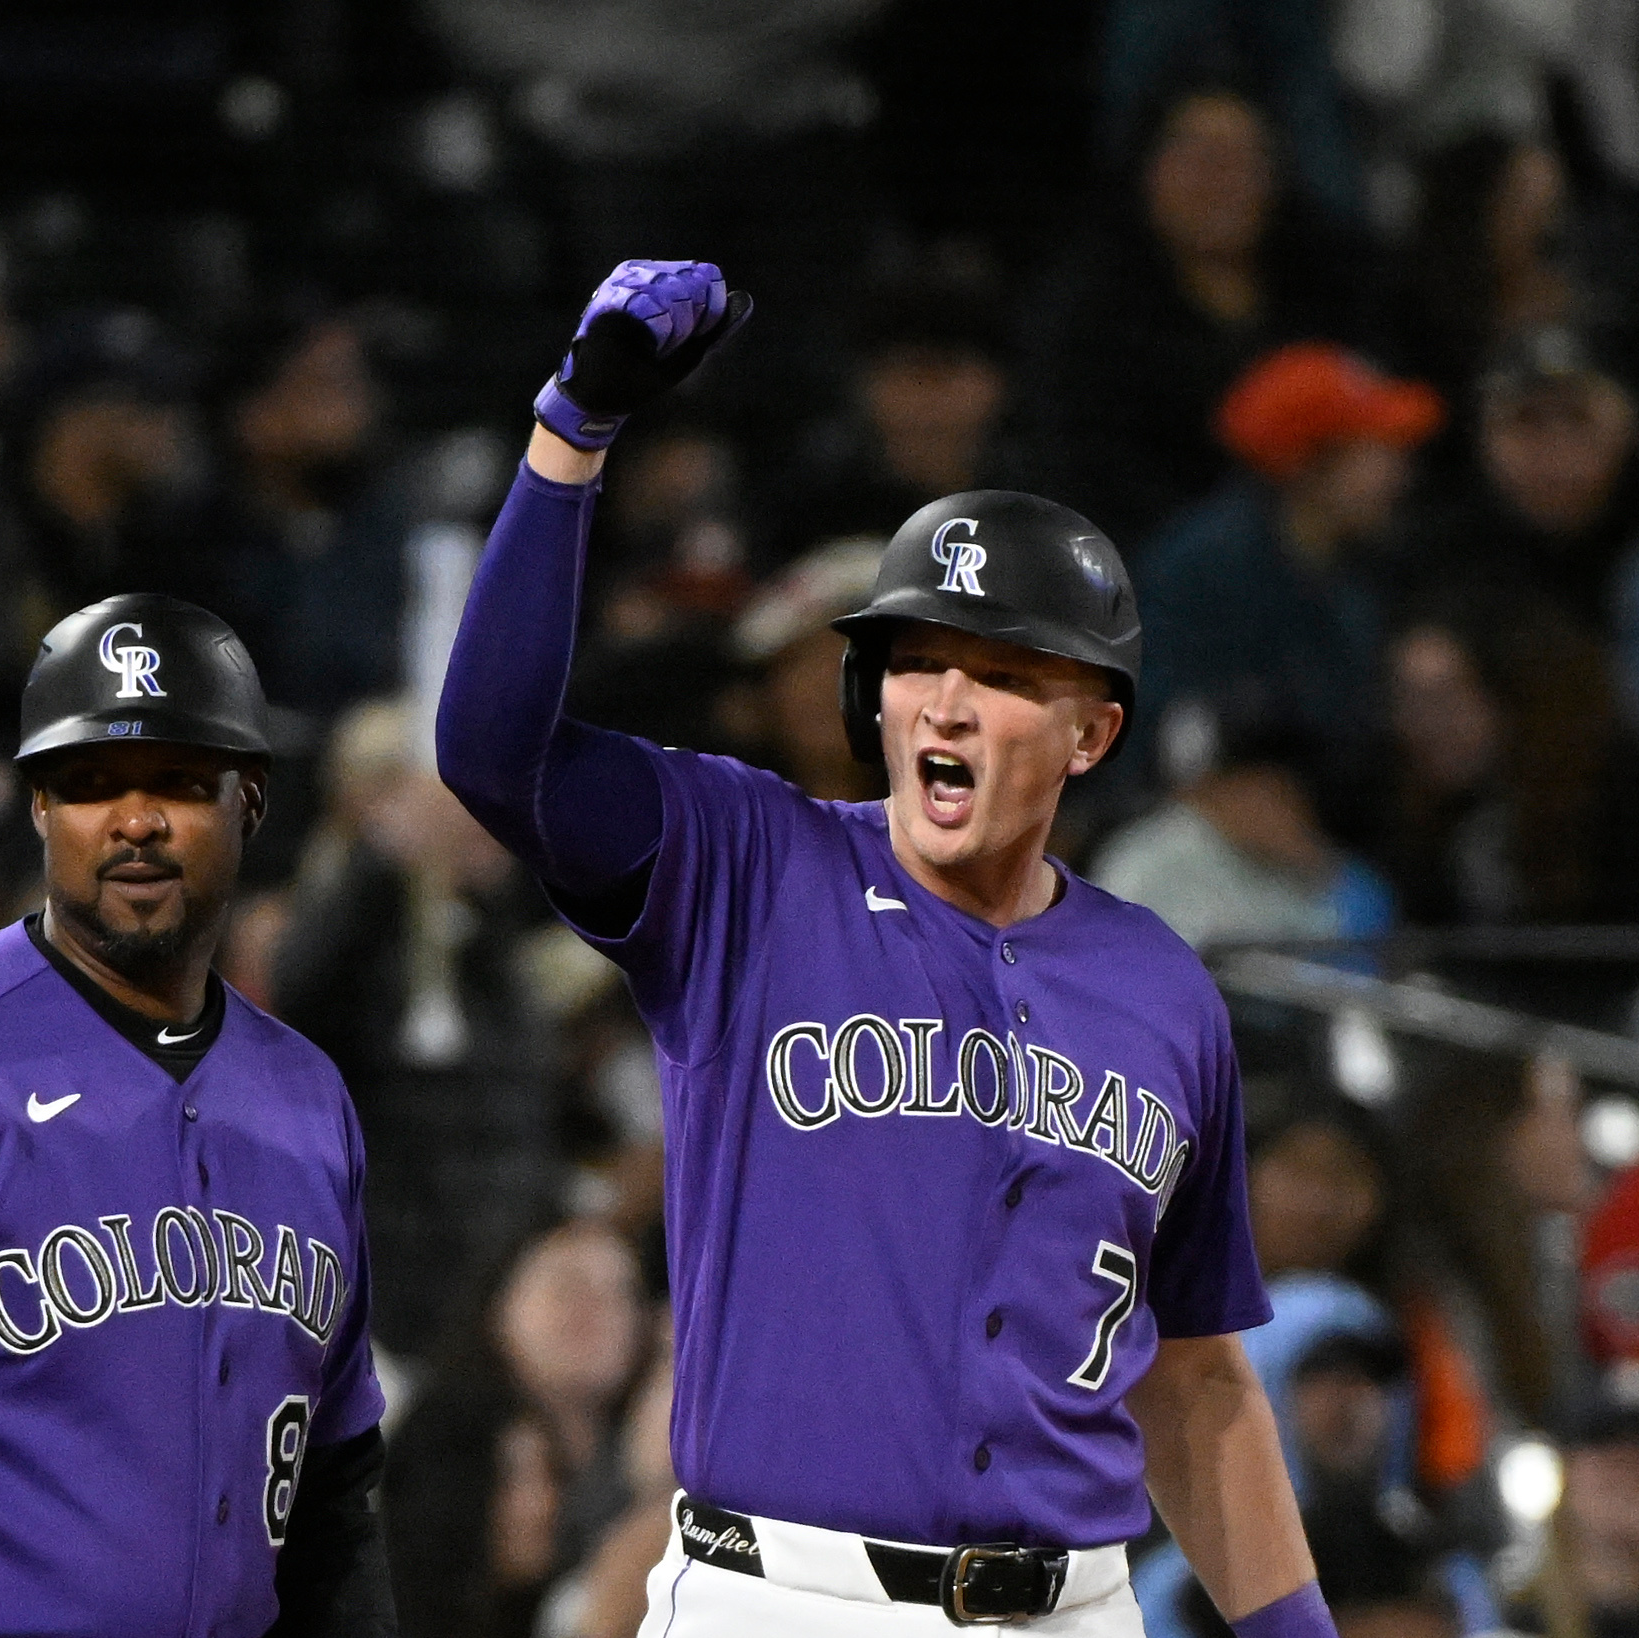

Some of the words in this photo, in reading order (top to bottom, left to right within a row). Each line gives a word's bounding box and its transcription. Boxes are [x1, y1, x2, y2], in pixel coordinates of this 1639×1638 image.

[931, 517, 987, 597] CR
[99, 622, 168, 699] CR
[107, 721, 142, 736] 81
[1066, 1239, 1137, 1391] 7
